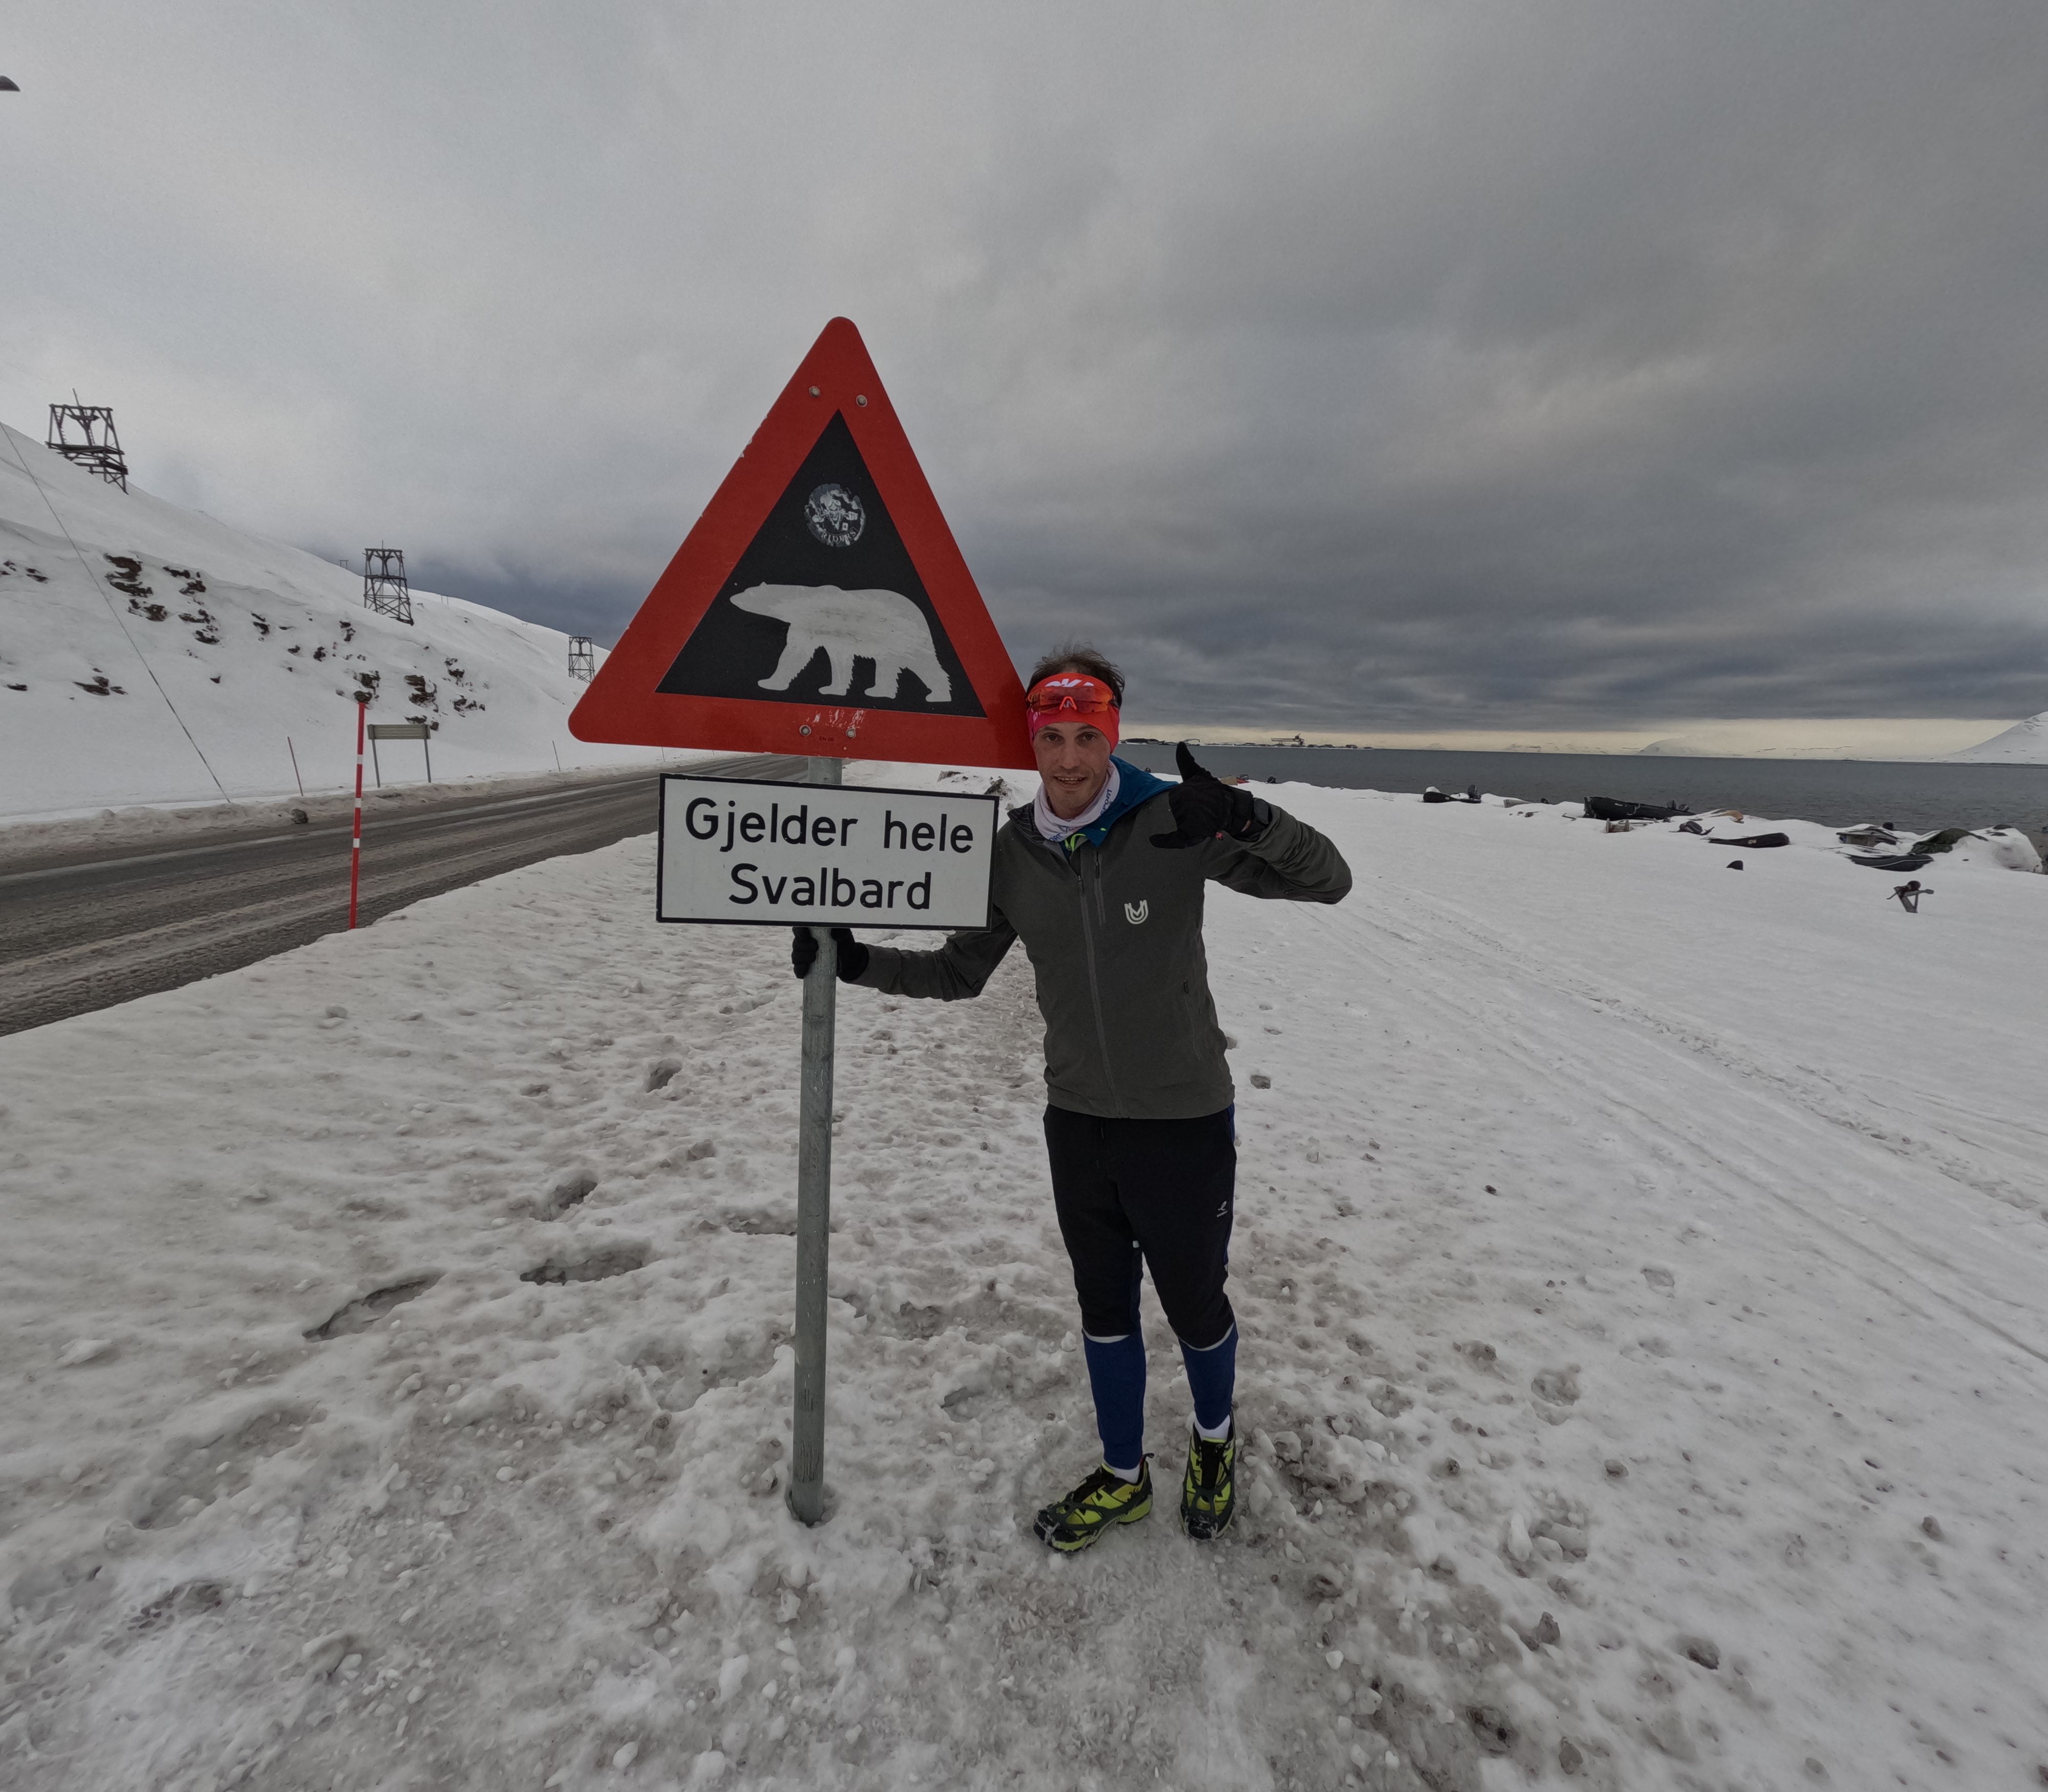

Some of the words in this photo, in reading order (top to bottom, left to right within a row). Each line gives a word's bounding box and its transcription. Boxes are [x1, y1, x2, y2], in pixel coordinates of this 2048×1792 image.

[686, 797, 859, 852] Gjelder
[884, 810, 973, 854] hele
[729, 863, 931, 910] Svalbard
